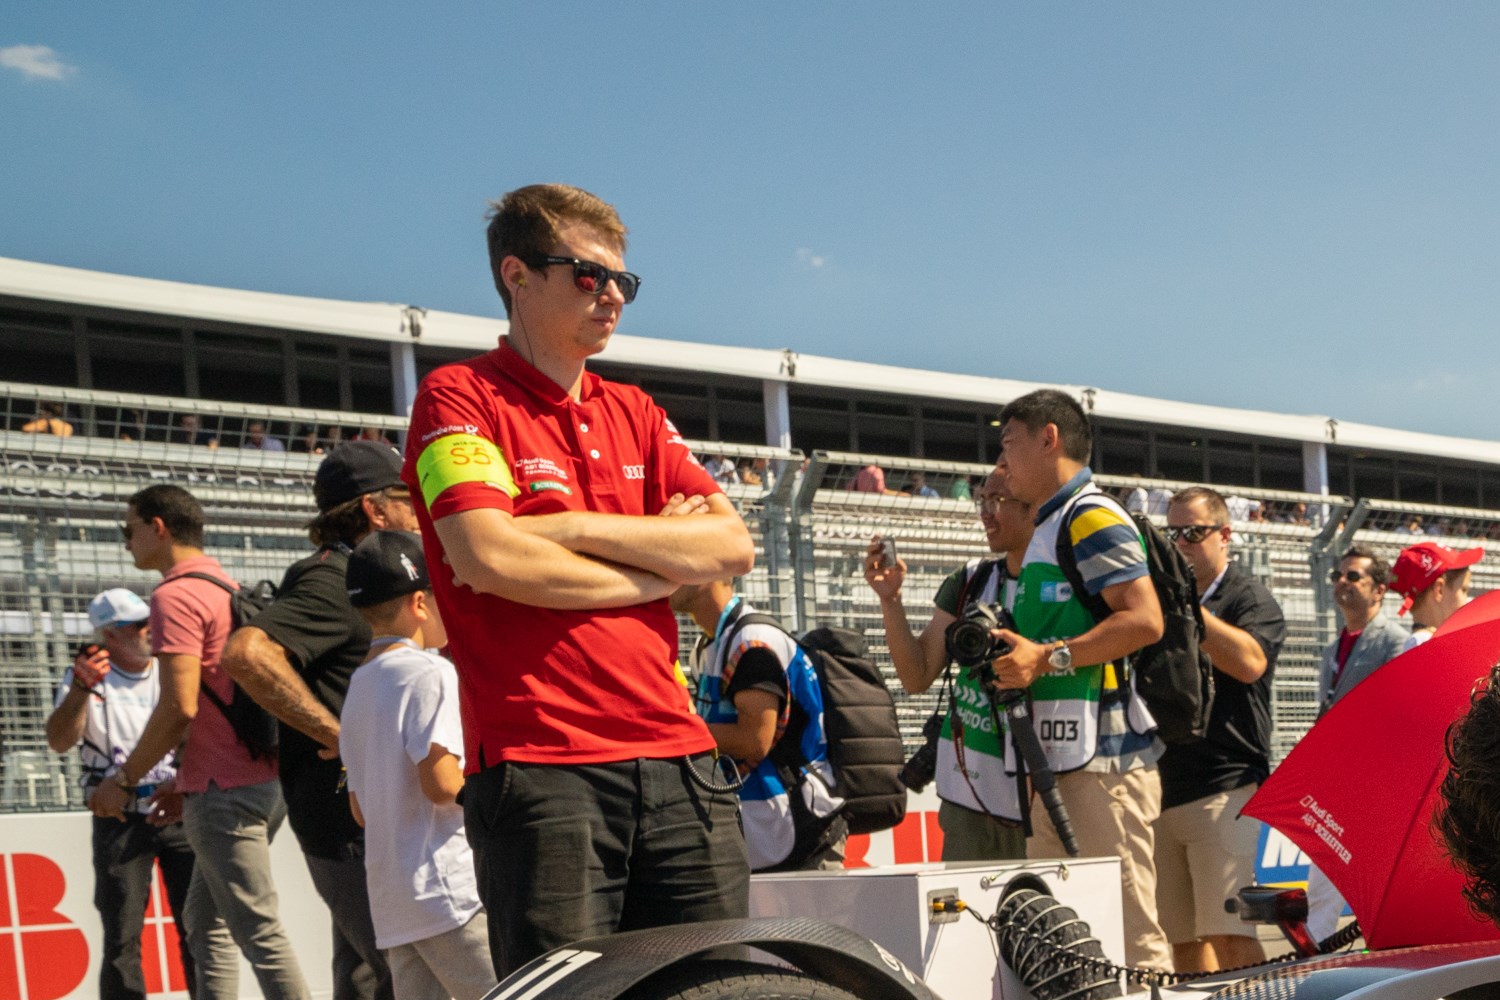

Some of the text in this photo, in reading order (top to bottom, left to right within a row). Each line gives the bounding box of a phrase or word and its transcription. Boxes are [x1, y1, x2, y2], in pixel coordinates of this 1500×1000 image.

[450, 447, 491, 465] S5
[1041, 720, 1079, 741] 003
[1309, 801, 1344, 836] Audi Sport
